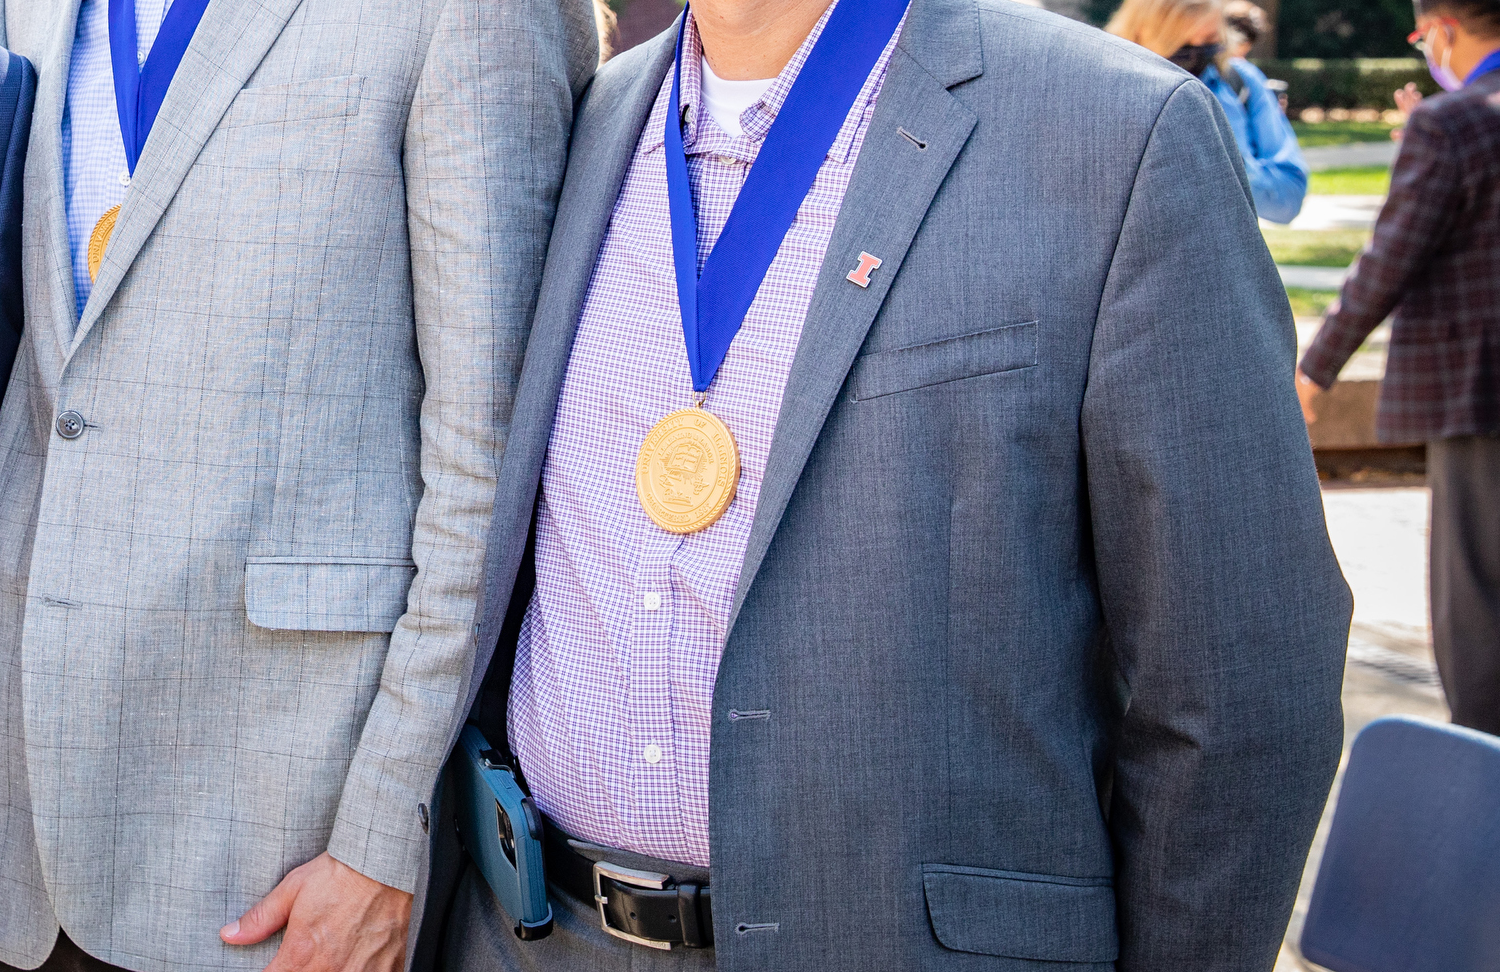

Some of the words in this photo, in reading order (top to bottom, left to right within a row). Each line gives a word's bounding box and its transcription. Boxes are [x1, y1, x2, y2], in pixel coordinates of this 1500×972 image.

[846, 251, 882, 288] I
[641, 416, 684, 475] UNIVERSITY
[695, 419, 707, 428] OF
[714, 433, 728, 487] ILLINOIS
[700, 435, 715, 465] LABOR
